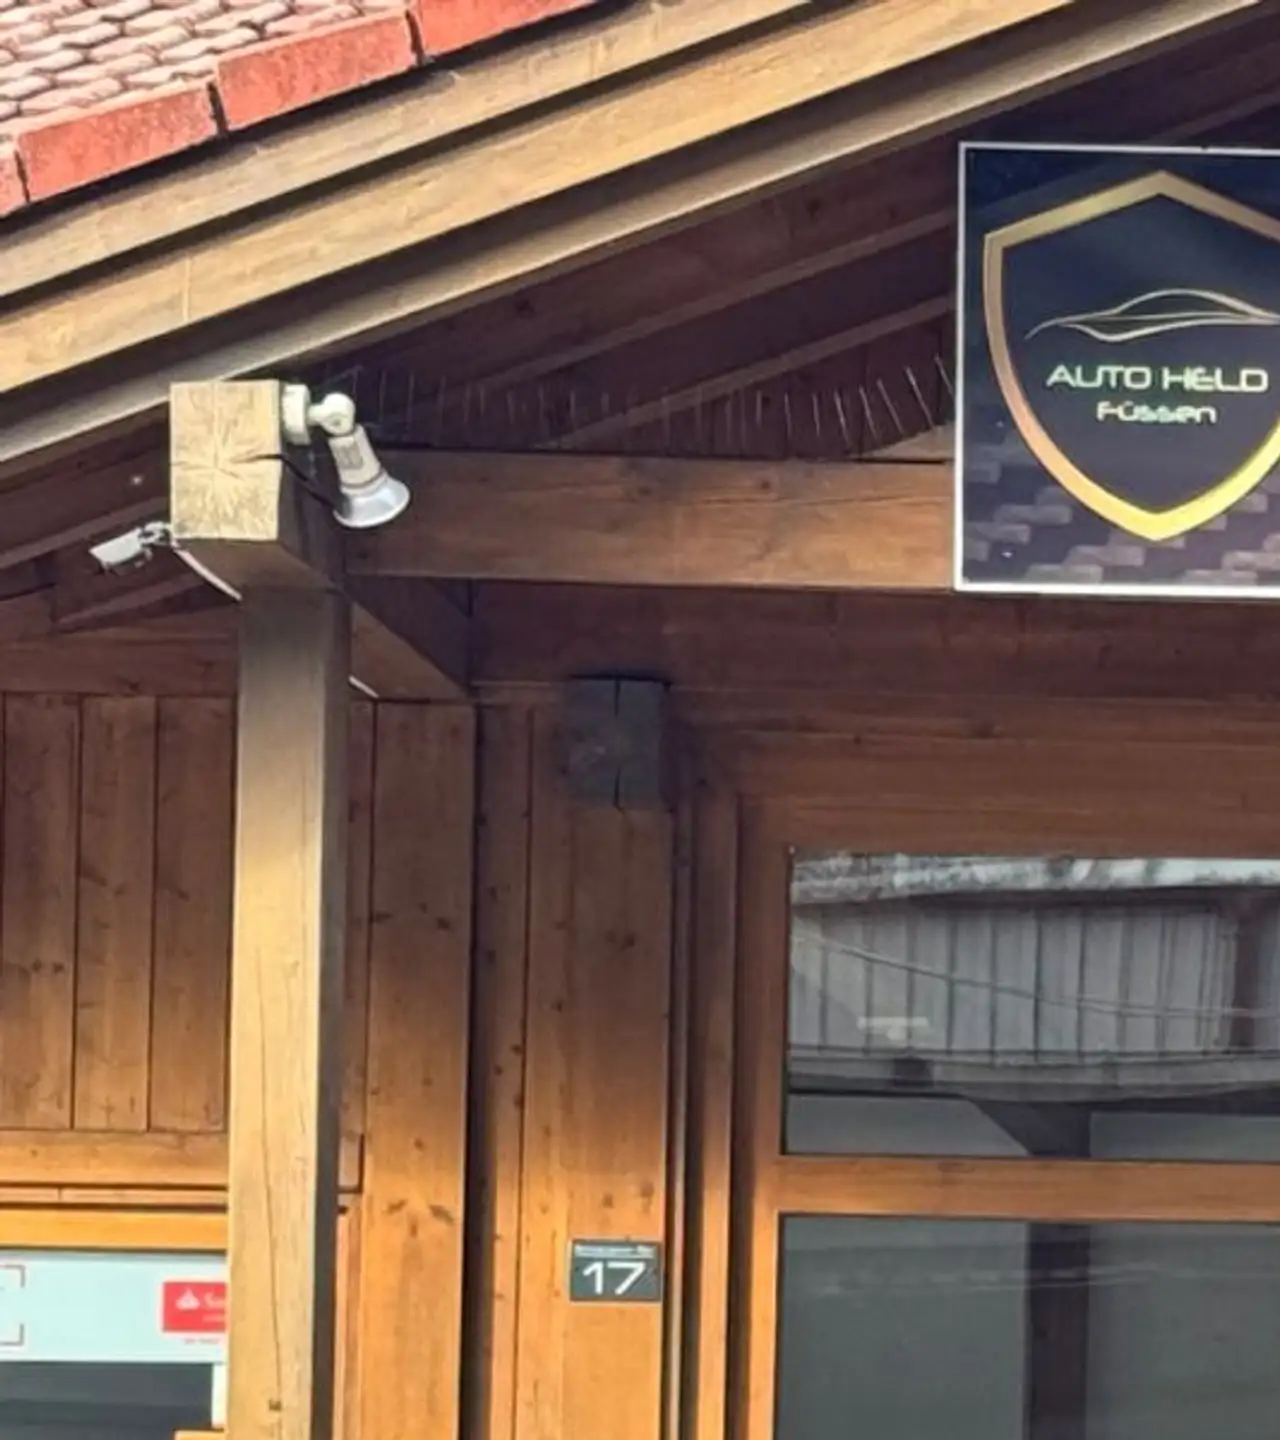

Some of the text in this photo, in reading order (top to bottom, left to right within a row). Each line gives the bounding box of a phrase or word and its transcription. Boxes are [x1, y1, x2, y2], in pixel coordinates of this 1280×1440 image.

[1046, 364, 1269, 393] AUTO HELD
[1096, 399, 1217, 424] Füssen
[582, 1260, 647, 1296] 17
